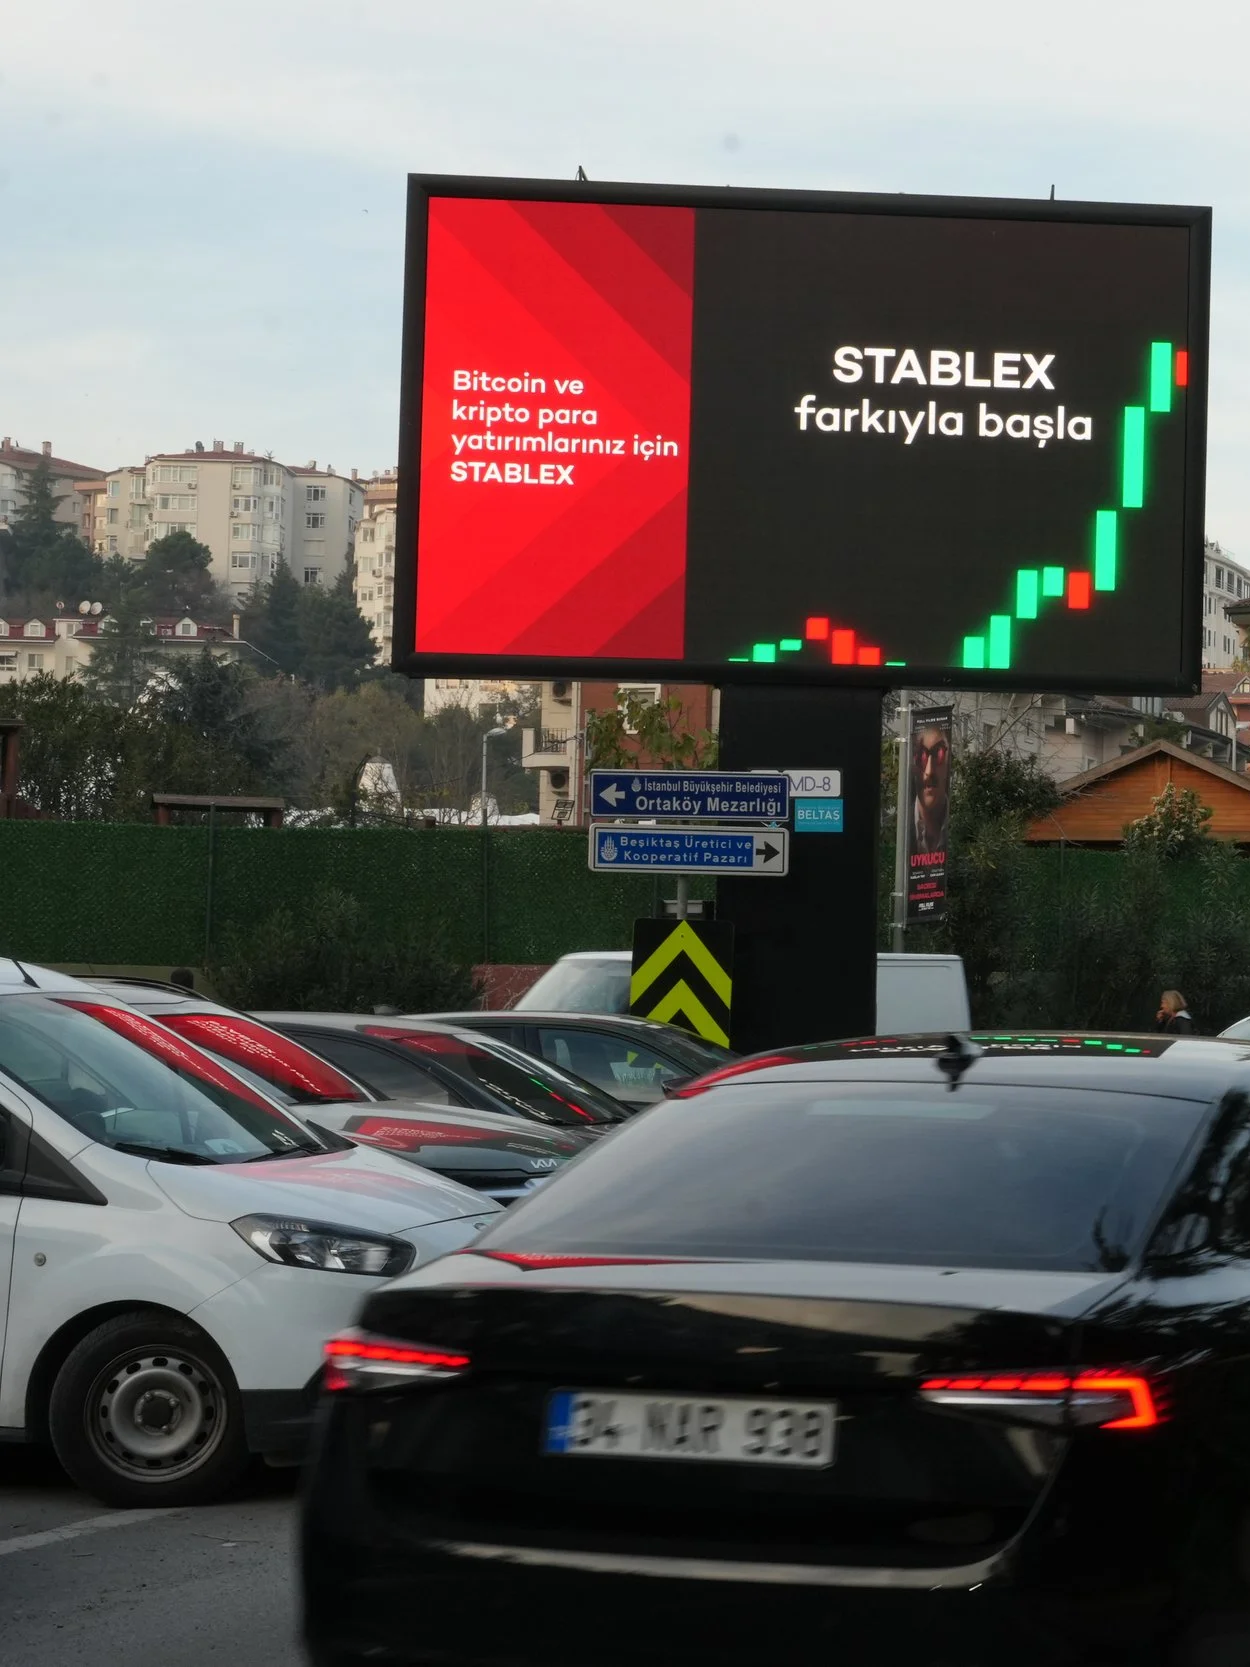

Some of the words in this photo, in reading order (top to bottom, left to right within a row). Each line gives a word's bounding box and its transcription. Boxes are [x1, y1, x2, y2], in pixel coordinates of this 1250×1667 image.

[832, 345, 1056, 390] STABLEX
[452, 370, 546, 394] Bitcoin
[553, 379, 584, 395] ve
[451, 399, 530, 428] kripto
[538, 408, 598, 429] para
[793, 394, 963, 445] farkıyla
[978, 402, 1092, 448] başla
[451, 430, 625, 456] yatırımlarınız
[633, 434, 679, 461] için
[450, 461, 575, 486] STABLEX
[644, 778, 681, 792] İstanbul
[683, 780, 733, 795] Büyükşehir
[735, 782, 781, 796] Belediyesi
[635, 795, 702, 815] Ortaköy
[707, 797, 781, 816] Mezarlığı
[797, 810, 840, 821] BELTAŞ
[620, 836, 680, 849] Beşiktaş
[684, 835, 732, 849] Üretici
[736, 841, 752, 850] ve
[624, 851, 699, 865] Kooperatif
[703, 852, 748, 864] Pazarı
[910, 851, 945, 867] UYKUCU
[573, 1399, 620, 1450] 34
